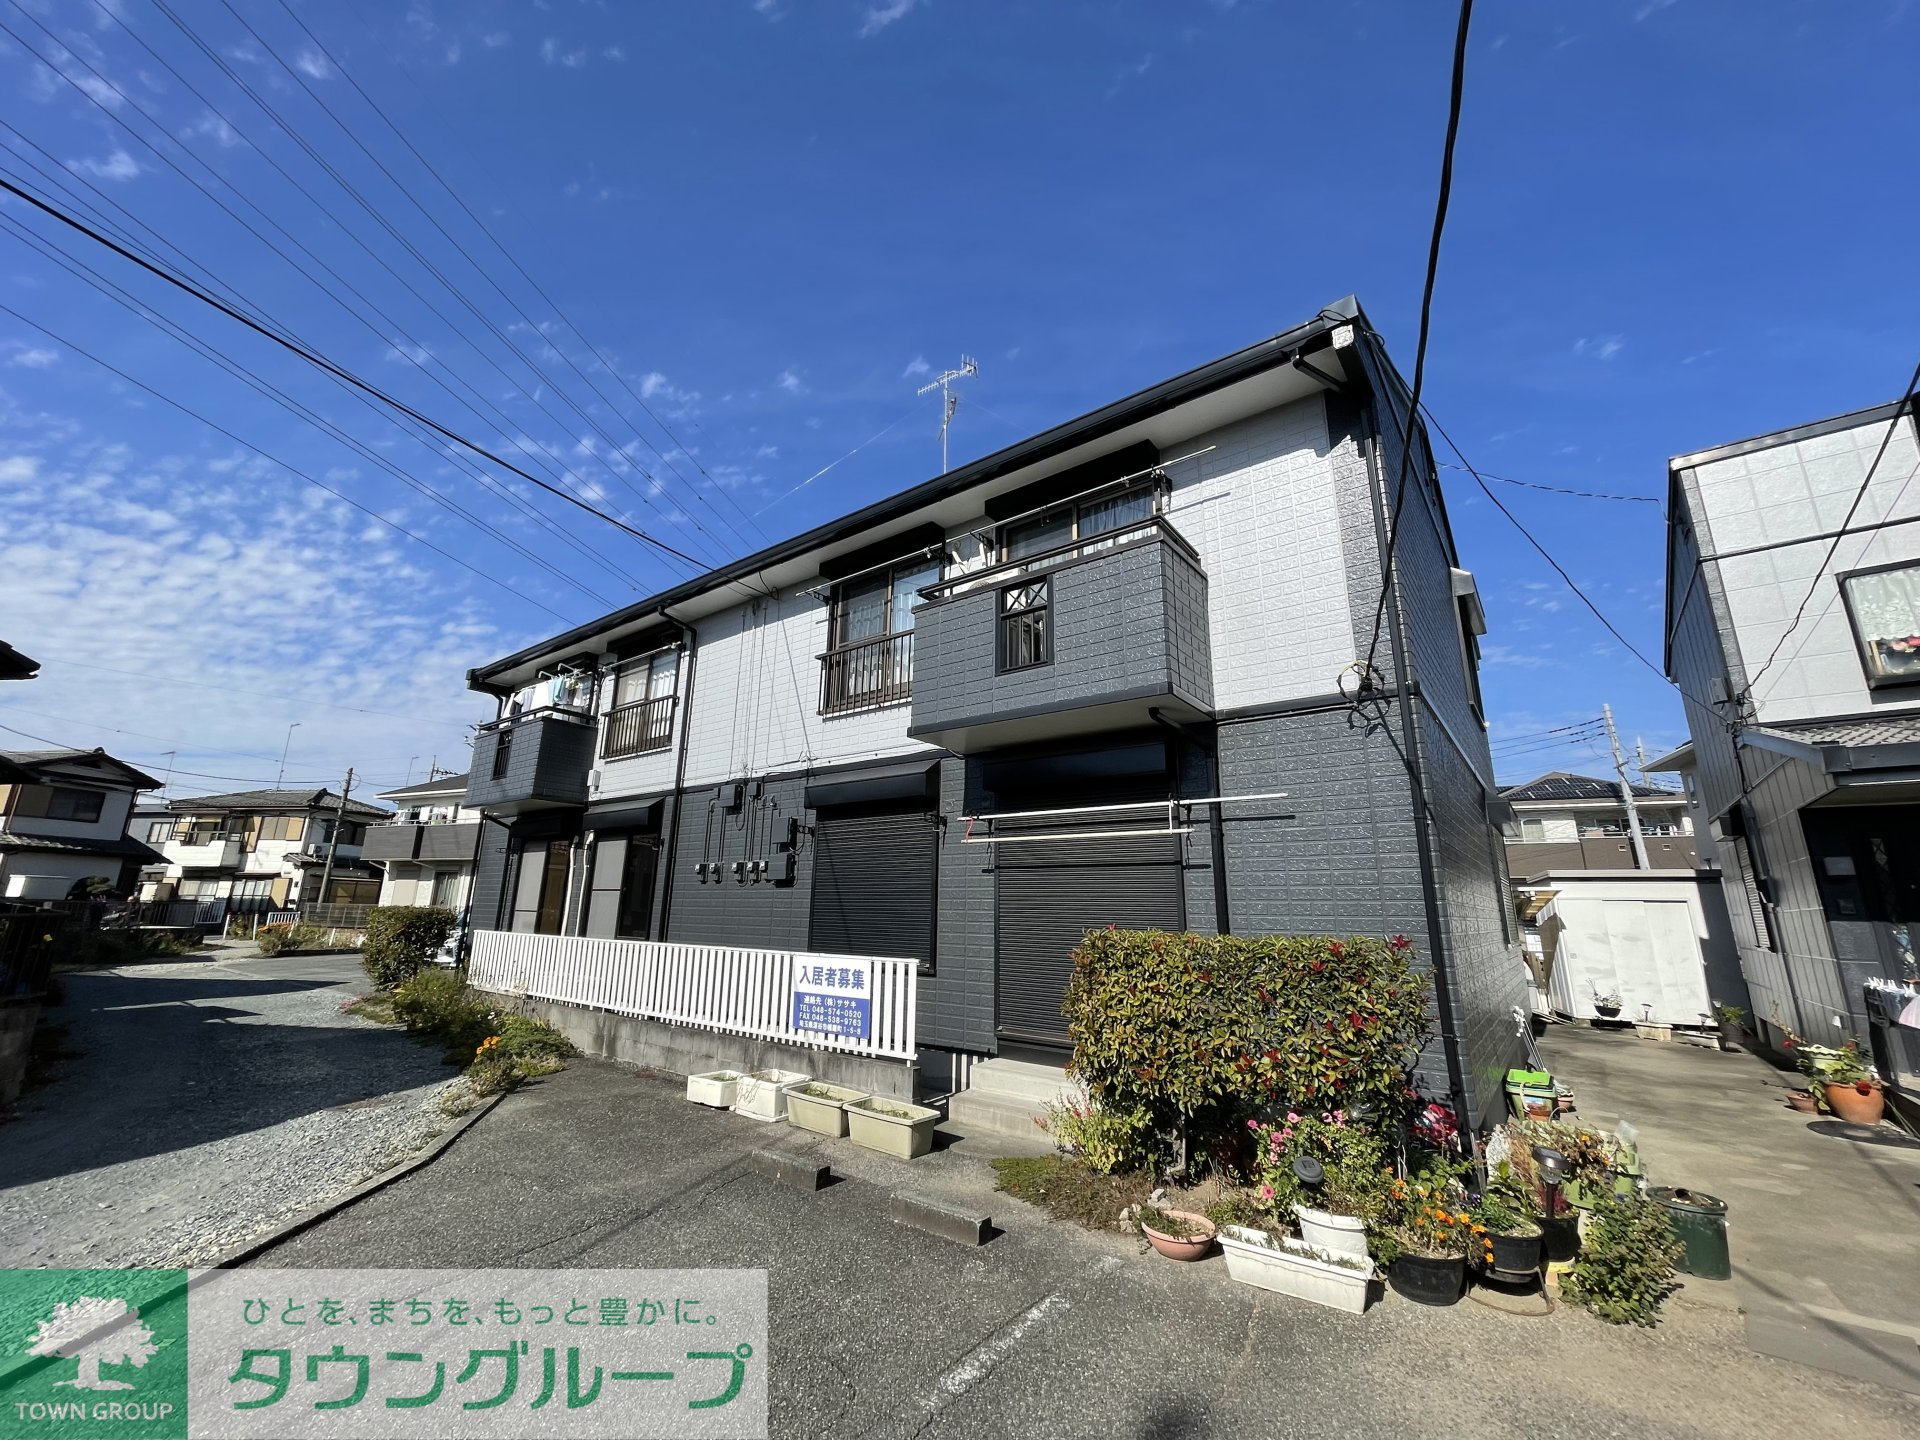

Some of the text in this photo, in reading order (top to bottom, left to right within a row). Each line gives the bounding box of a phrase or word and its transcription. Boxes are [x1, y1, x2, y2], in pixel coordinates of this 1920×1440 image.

[799, 965, 865, 990] 入居者募集
[799, 1004, 862, 1018] TEL 048-574-0520
[799, 1012, 862, 1027] FAX 048-538-9763
